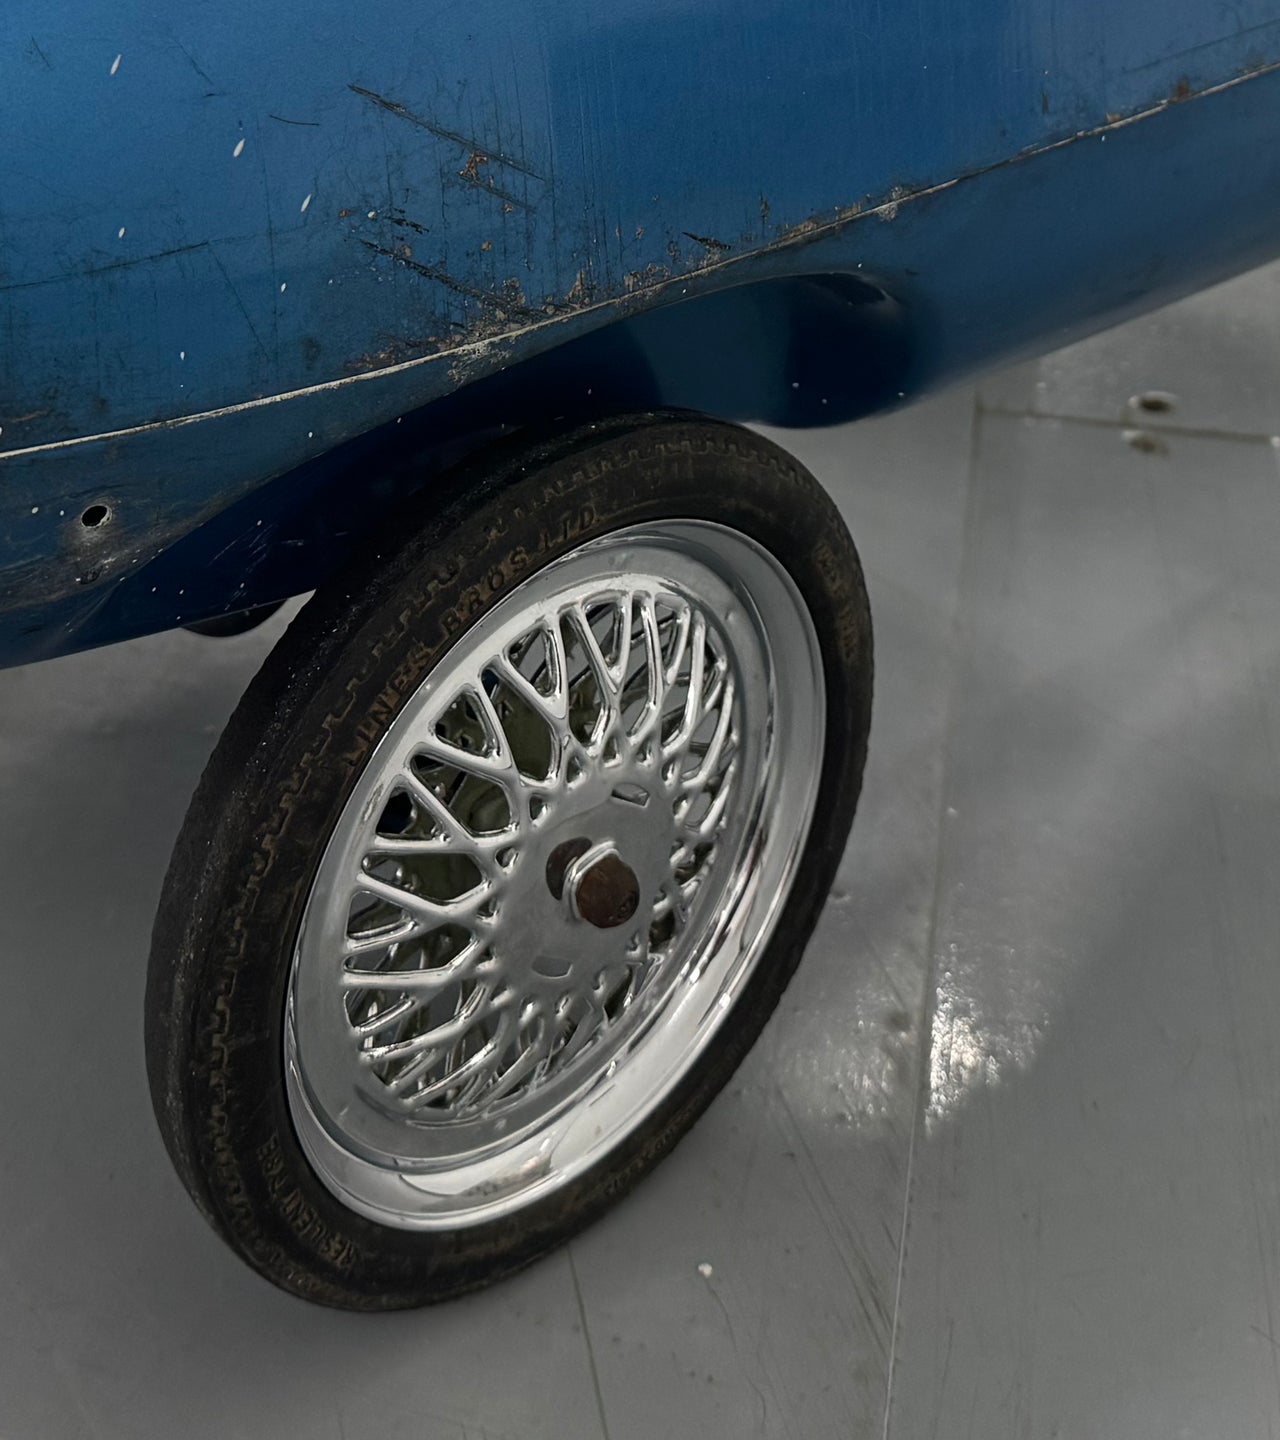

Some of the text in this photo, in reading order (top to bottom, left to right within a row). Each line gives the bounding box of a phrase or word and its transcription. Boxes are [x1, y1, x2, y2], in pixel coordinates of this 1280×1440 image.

[343, 642, 432, 767] LINES
[441, 545, 530, 635] BROS
[279, 1186, 360, 1272] RESILIENT
